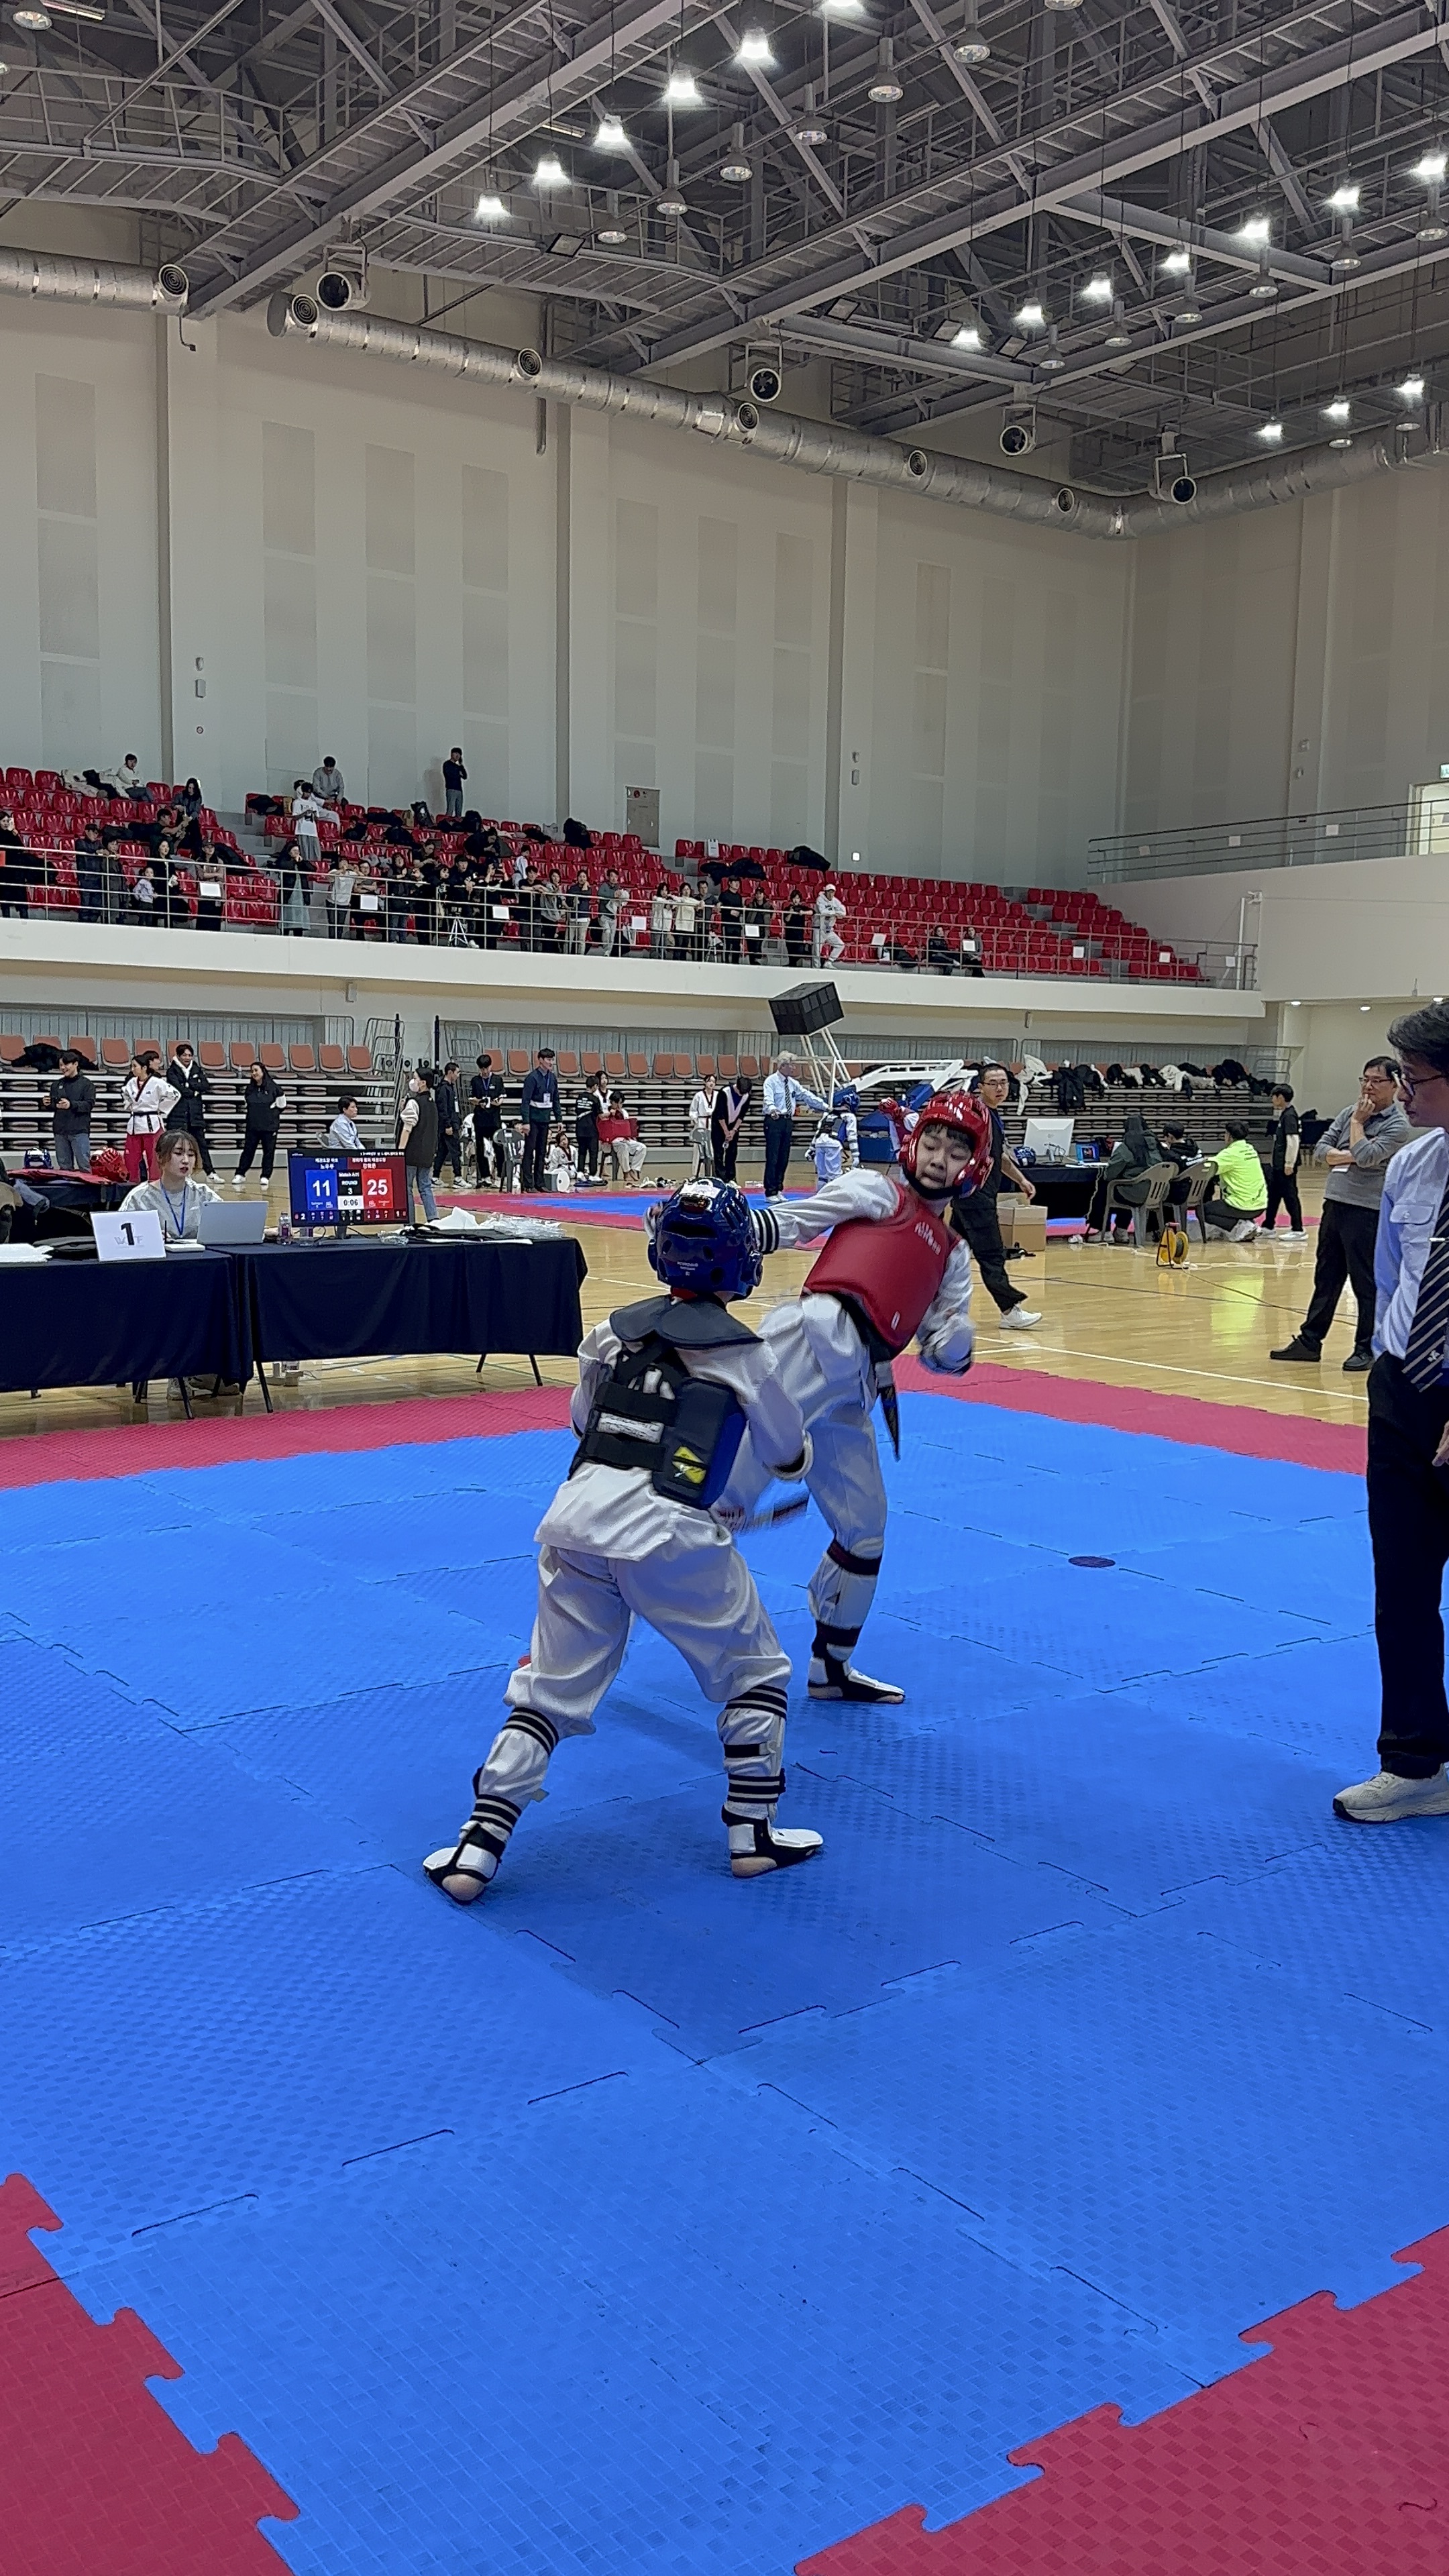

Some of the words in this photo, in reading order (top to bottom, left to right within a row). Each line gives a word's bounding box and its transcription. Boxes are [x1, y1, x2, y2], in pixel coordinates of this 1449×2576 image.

[313, 1179, 331, 1197] 11
[367, 1179, 388, 1195] 25
[121, 1222, 135, 1246] 1
